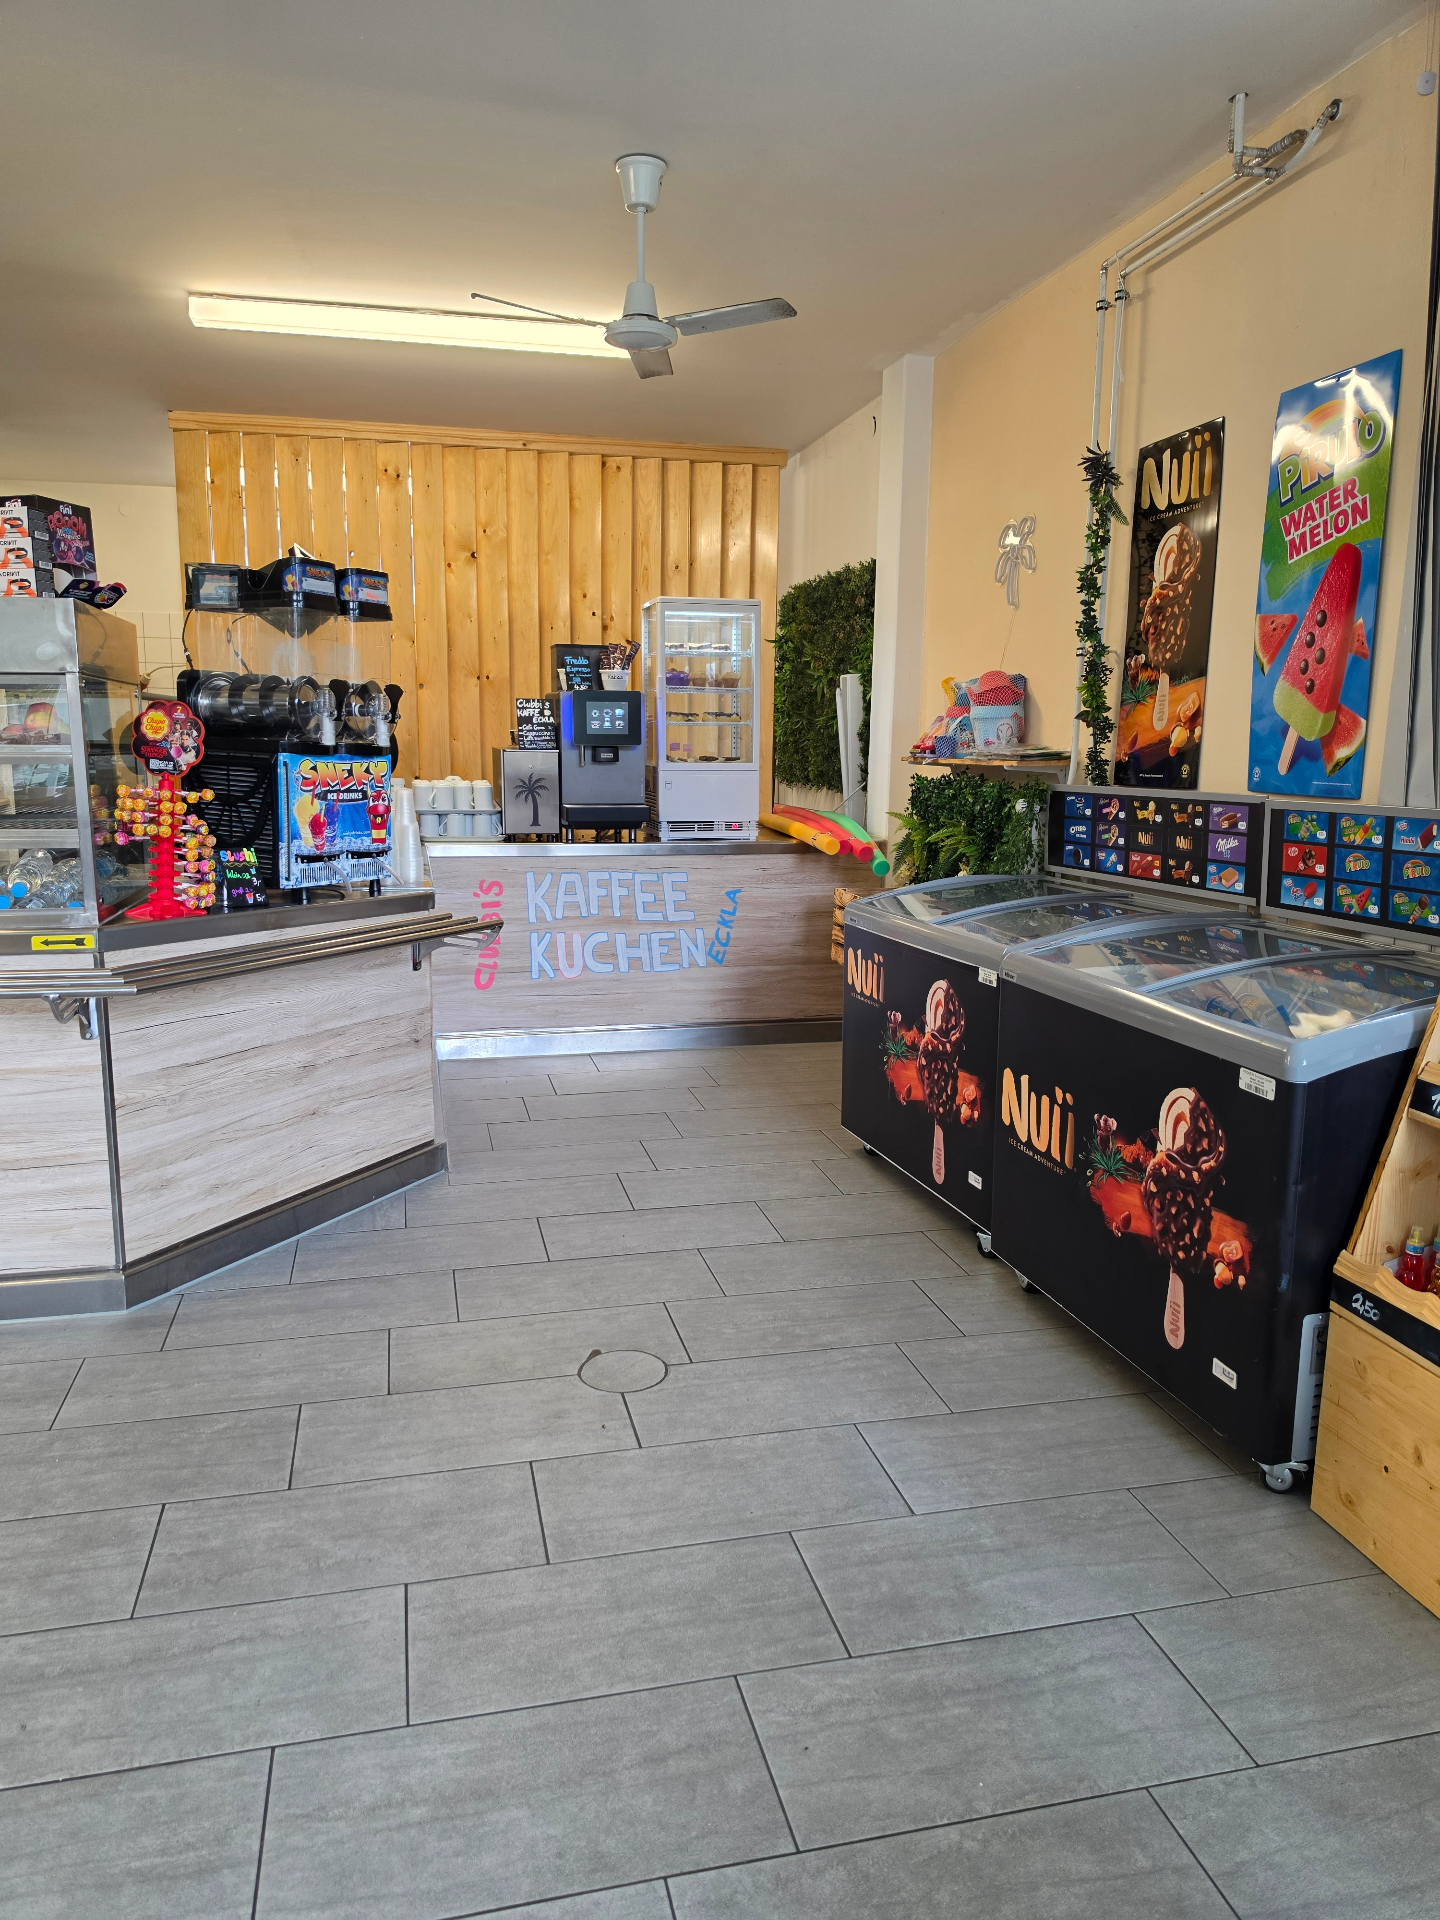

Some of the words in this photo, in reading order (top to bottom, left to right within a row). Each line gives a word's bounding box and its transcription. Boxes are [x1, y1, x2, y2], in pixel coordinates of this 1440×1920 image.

[1141, 432, 1213, 511] Nuii
[1157, 511, 1173, 520] CREAM
[1174, 503, 1202, 516] ADVENTURE
[1280, 477, 1359, 538] WATER
[1287, 494, 1370, 564] MELON
[145, 723, 165, 734] Chups
[146, 716, 166, 726] Chupa
[299, 758, 389, 793] SNEKY
[327, 792, 338, 800] ICE
[339, 792, 363, 800] DRINKS
[1138, 831, 1154, 846] Nuii
[1176, 836, 1193, 850] Nuii
[1215, 836, 1240, 853] Milka
[1345, 859, 1371, 873] PIRULO
[1403, 865, 1431, 880] PIRULO
[525, 871, 696, 924] KAFFEE
[707, 888, 742, 966] ECKLA
[529, 928, 708, 980] KUCHEN
[847, 946, 885, 1003] Nuii
[1001, 1067, 1075, 1170] Nuii
[1008, 1137, 1017, 1147] ICE
[1017, 1143, 1034, 1158] CREAM
[1034, 1153, 1064, 1176] ADVENTURE
[1169, 1299, 1182, 1338] Nuii
